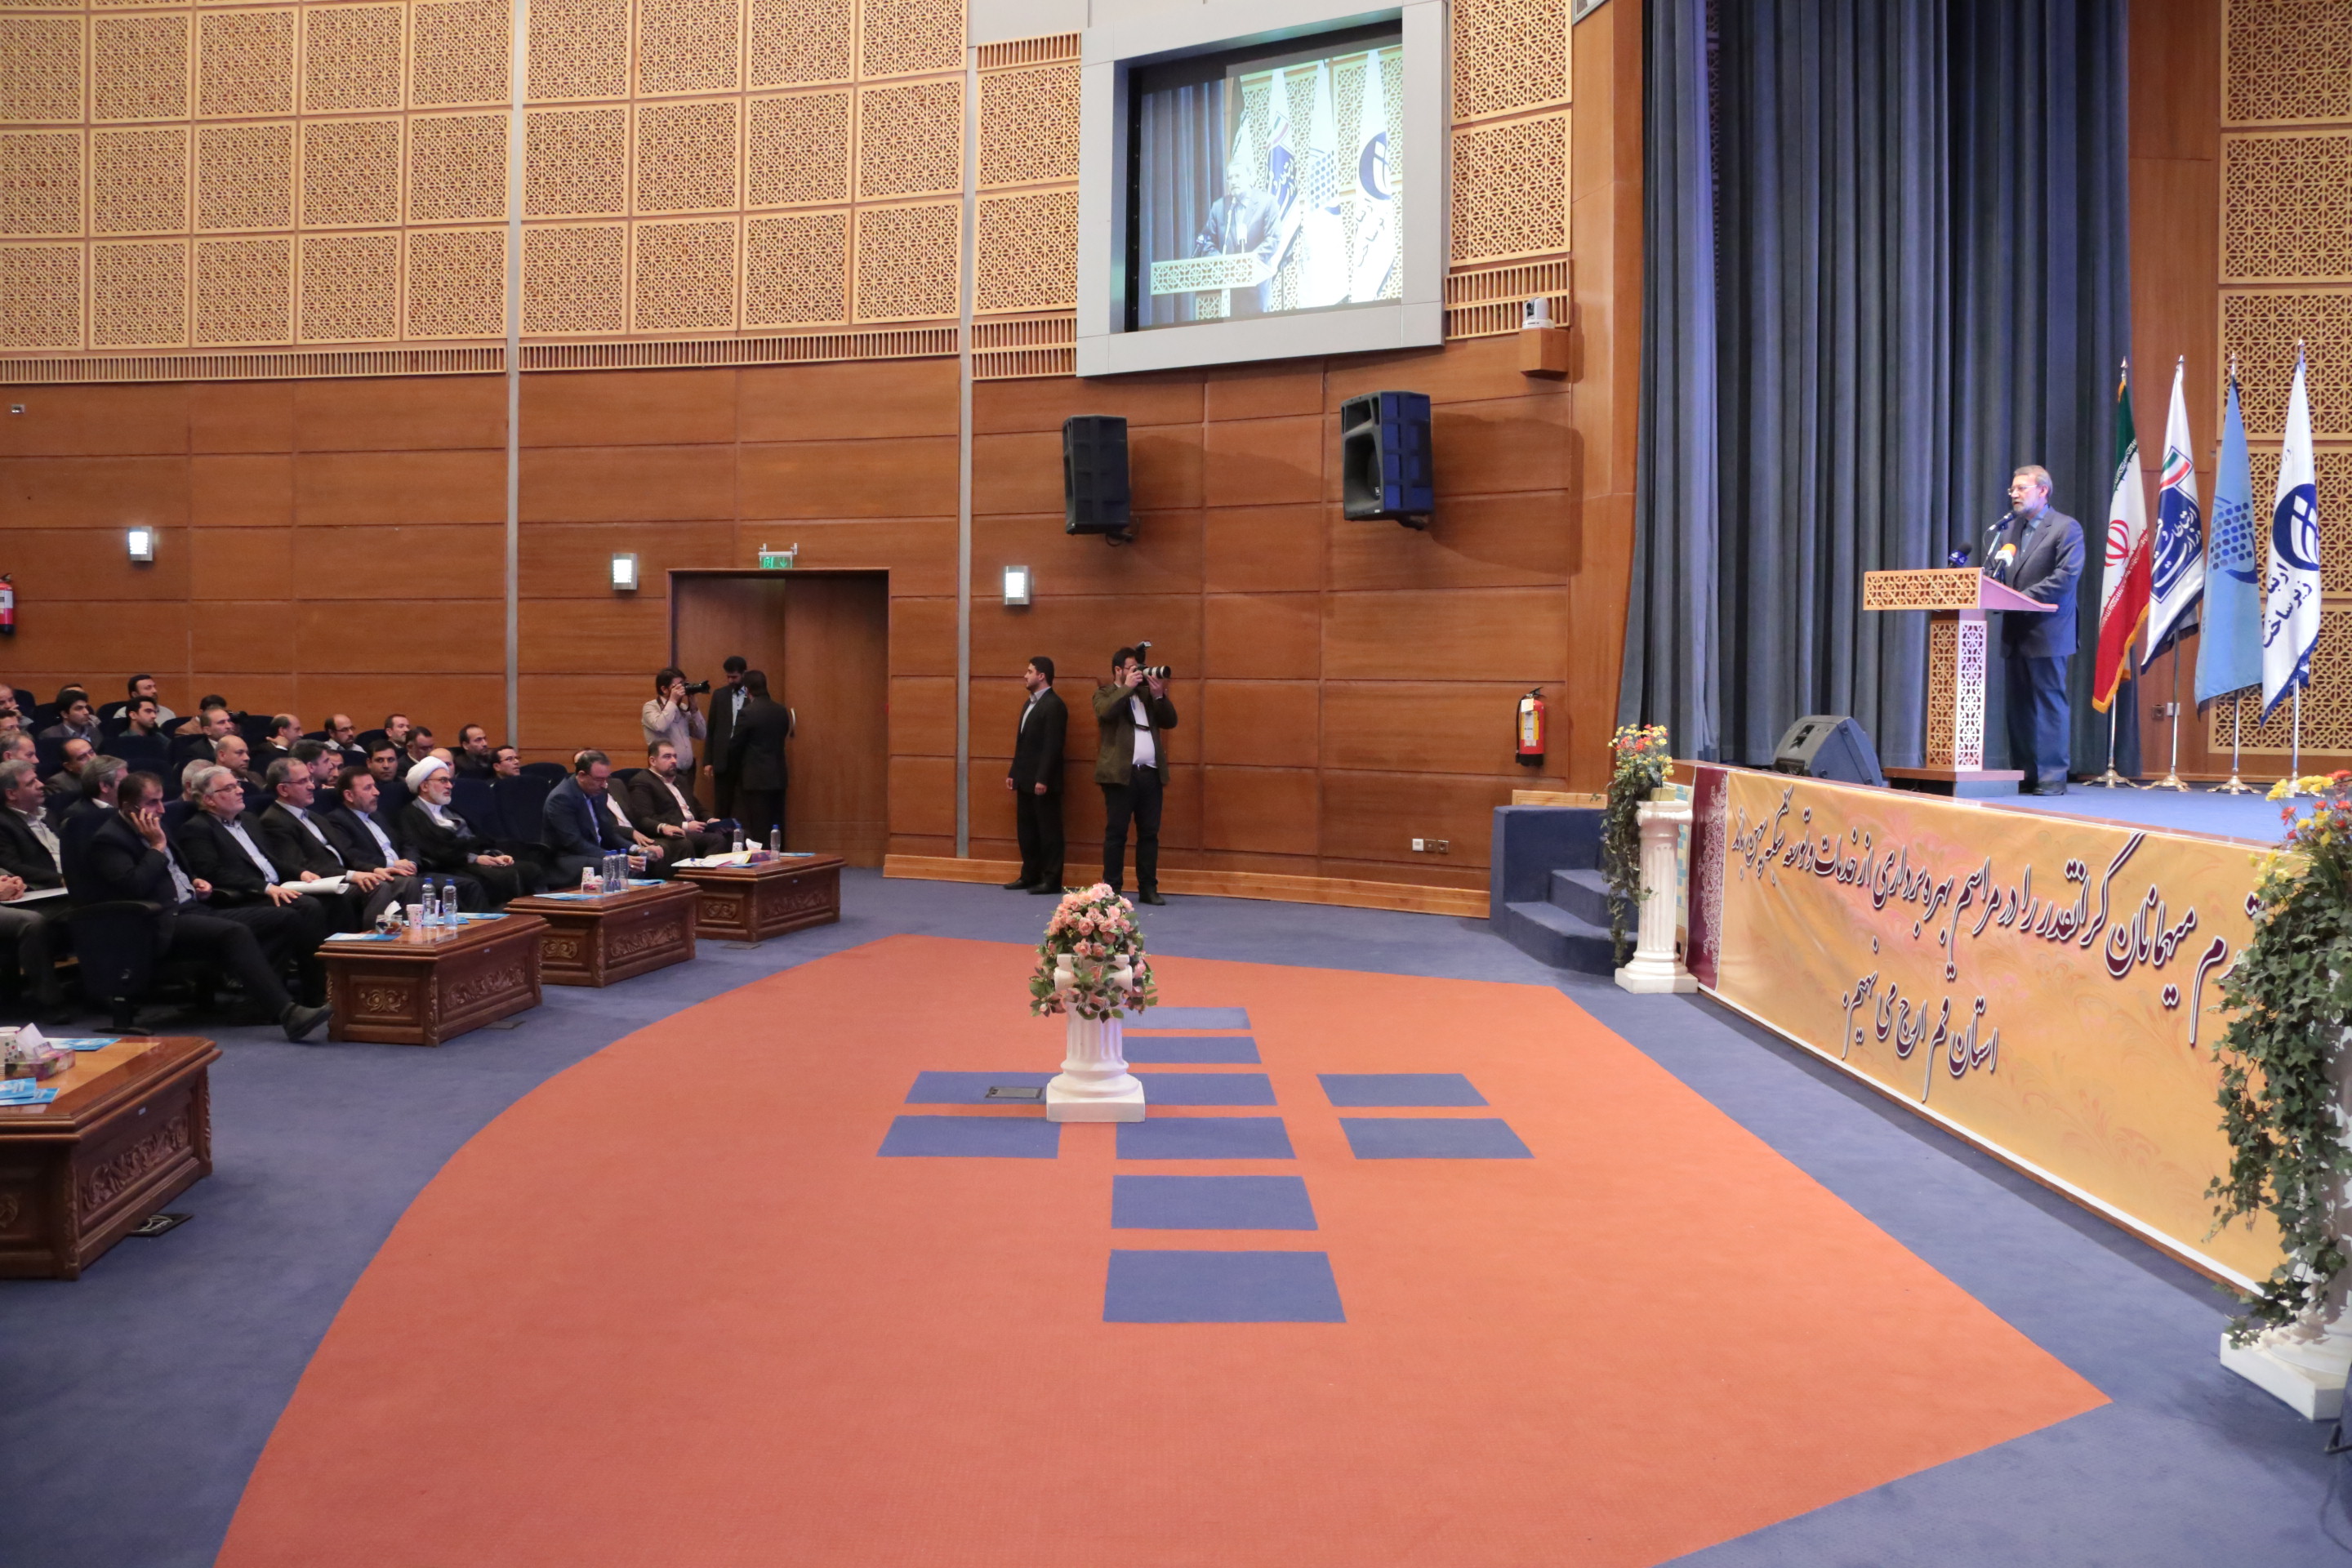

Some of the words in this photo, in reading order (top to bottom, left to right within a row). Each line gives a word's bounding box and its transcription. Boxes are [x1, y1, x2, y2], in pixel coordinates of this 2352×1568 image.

[1731, 805, 1746, 881] باند
[1744, 816, 1768, 880] پهن
[1764, 782, 1794, 887] شبکه
[1782, 805, 1812, 869] توسعه
[1804, 841, 1815, 871] و
[1812, 826, 1859, 883] خدمات
[1855, 831, 1874, 885] از
[1947, 855, 2002, 967] مراسم
[1998, 885, 2019, 926] در
[2019, 863, 2039, 930] را
[2105, 883, 2197, 1007] میهمانان
[1875, 982, 1898, 1040] می
[1895, 996, 1928, 1058] ارج
[1921, 960, 1957, 1102] قم
[1947, 995, 1999, 1077] استان
